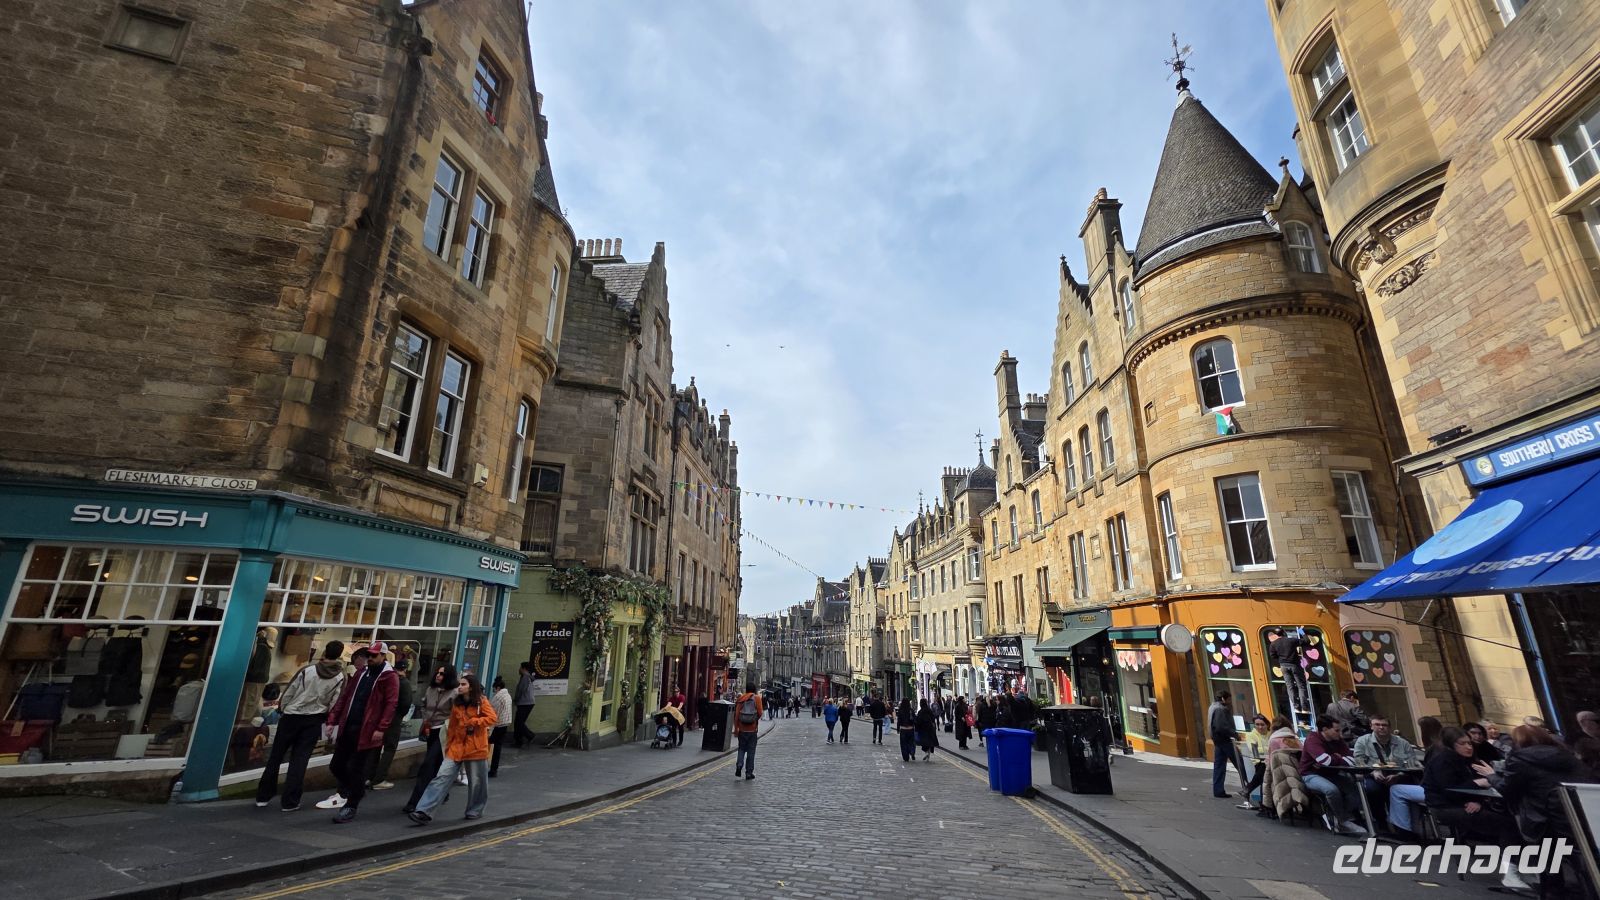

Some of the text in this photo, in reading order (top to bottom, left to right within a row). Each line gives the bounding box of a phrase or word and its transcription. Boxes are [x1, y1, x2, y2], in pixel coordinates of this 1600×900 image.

[1499, 439, 1555, 467] SOUTHERN
[1554, 425, 1595, 449] CROSS
[107, 470, 255, 490] FLESHMARKET CLOSE
[70, 504, 209, 528] SWISH
[480, 556, 517, 575] SWISH
[1467, 551, 1554, 574] CROSS
[535, 628, 572, 637] arcade
